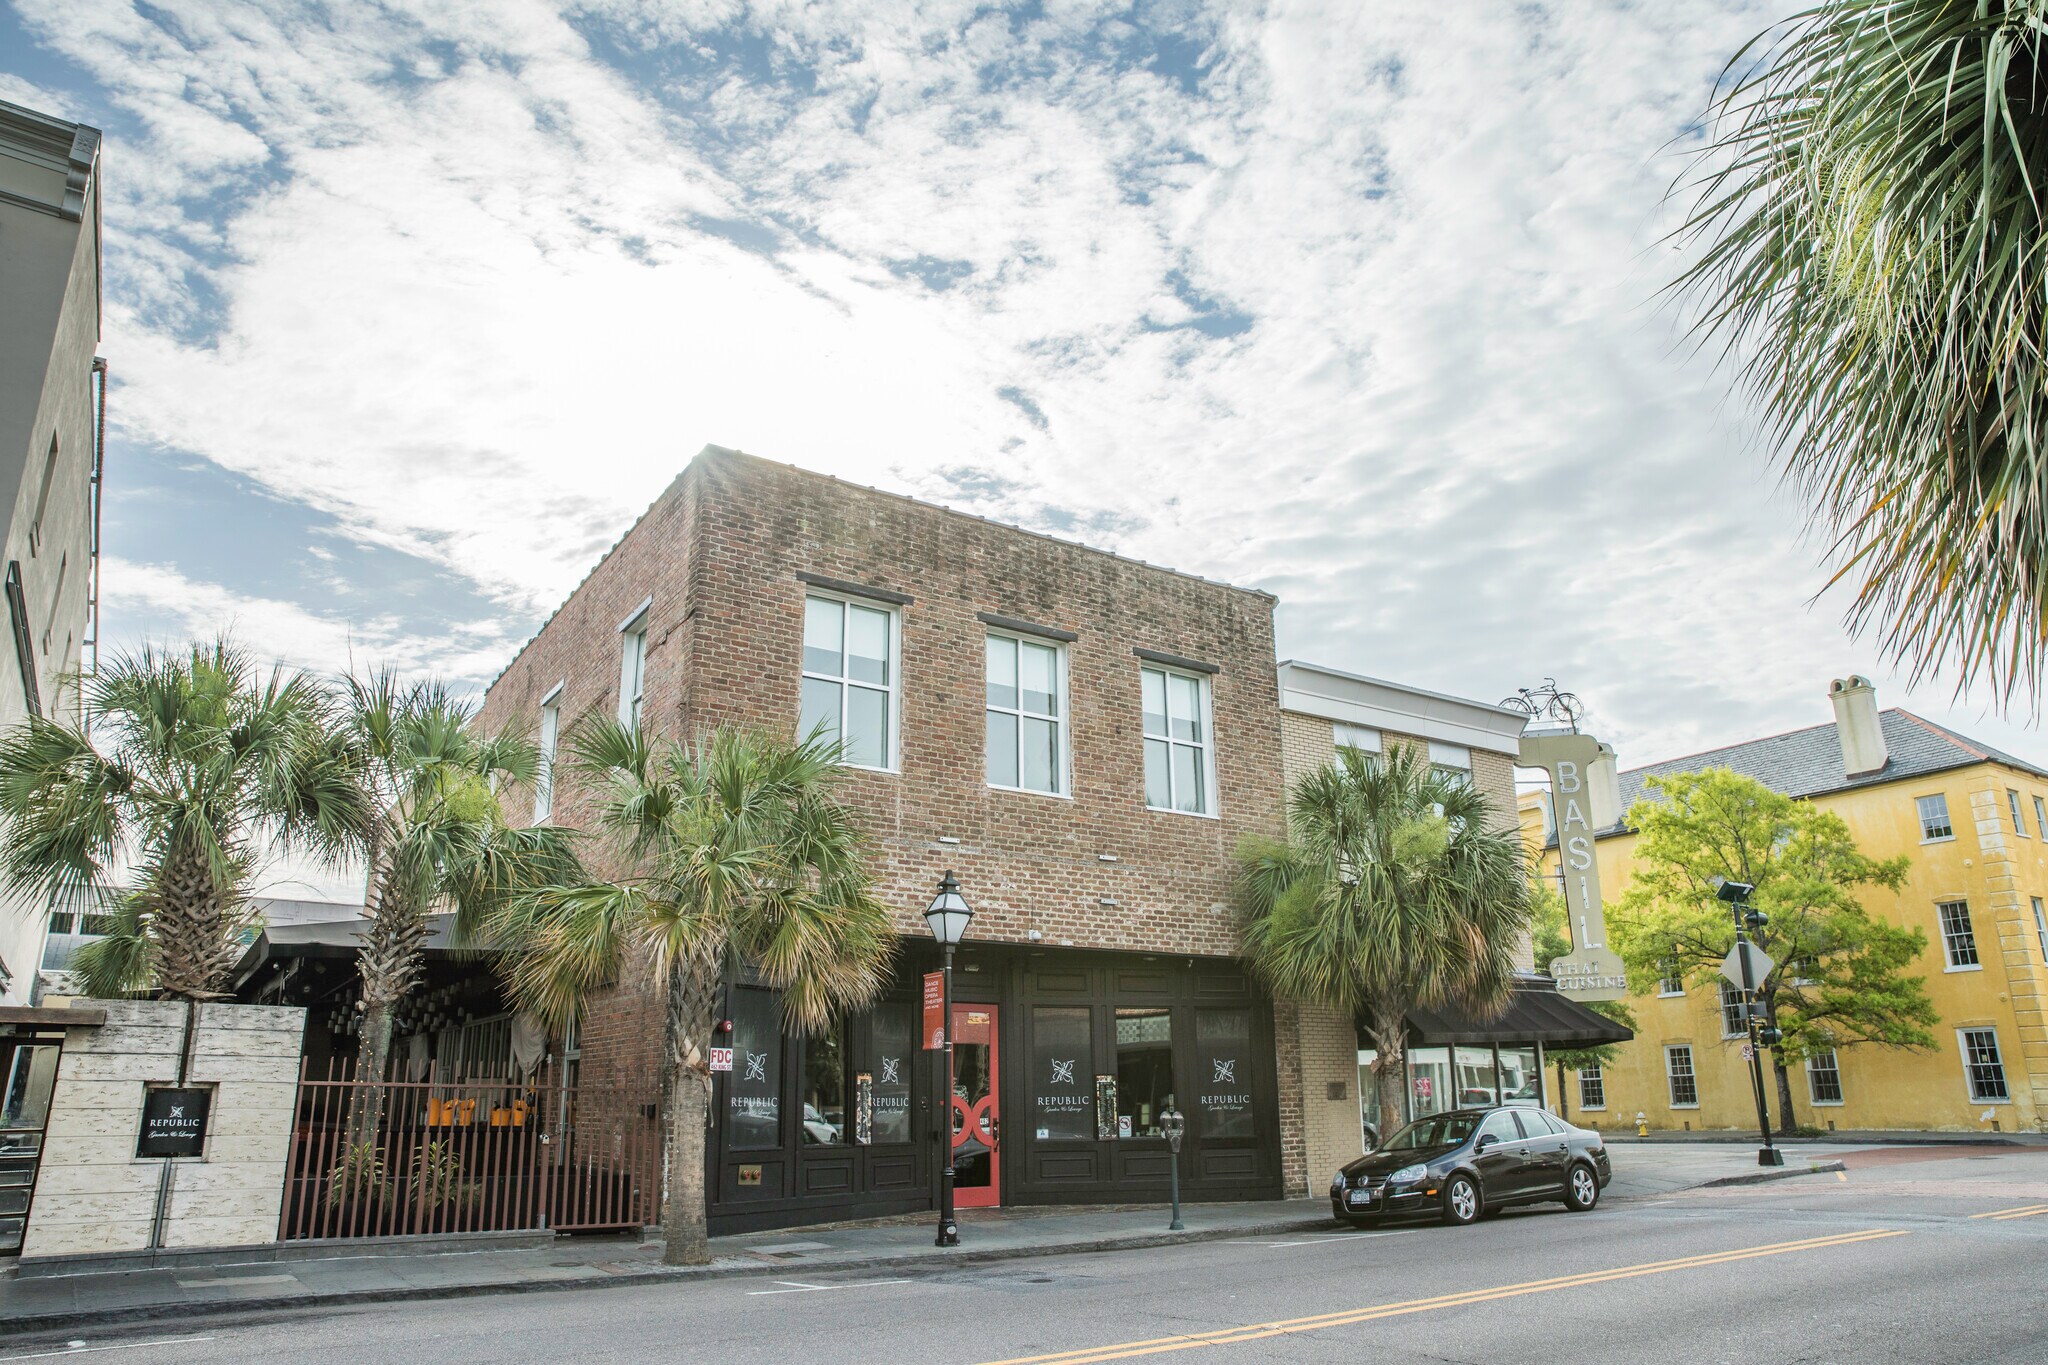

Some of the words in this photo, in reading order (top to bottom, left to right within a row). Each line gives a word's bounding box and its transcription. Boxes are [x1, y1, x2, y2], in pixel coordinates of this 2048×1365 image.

[1557, 761, 1602, 949] BASIL
[1554, 961, 1598, 976] THAI
[1557, 976, 1626, 991] CUISINE
[711, 1049, 732, 1064] FDC
[731, 1097, 778, 1107] REPUBLIC
[1037, 1096, 1090, 1106] REPUBLIC
[1201, 1095, 1250, 1104] REPUBLIC
[150, 1119, 200, 1127] REPUBLIC
